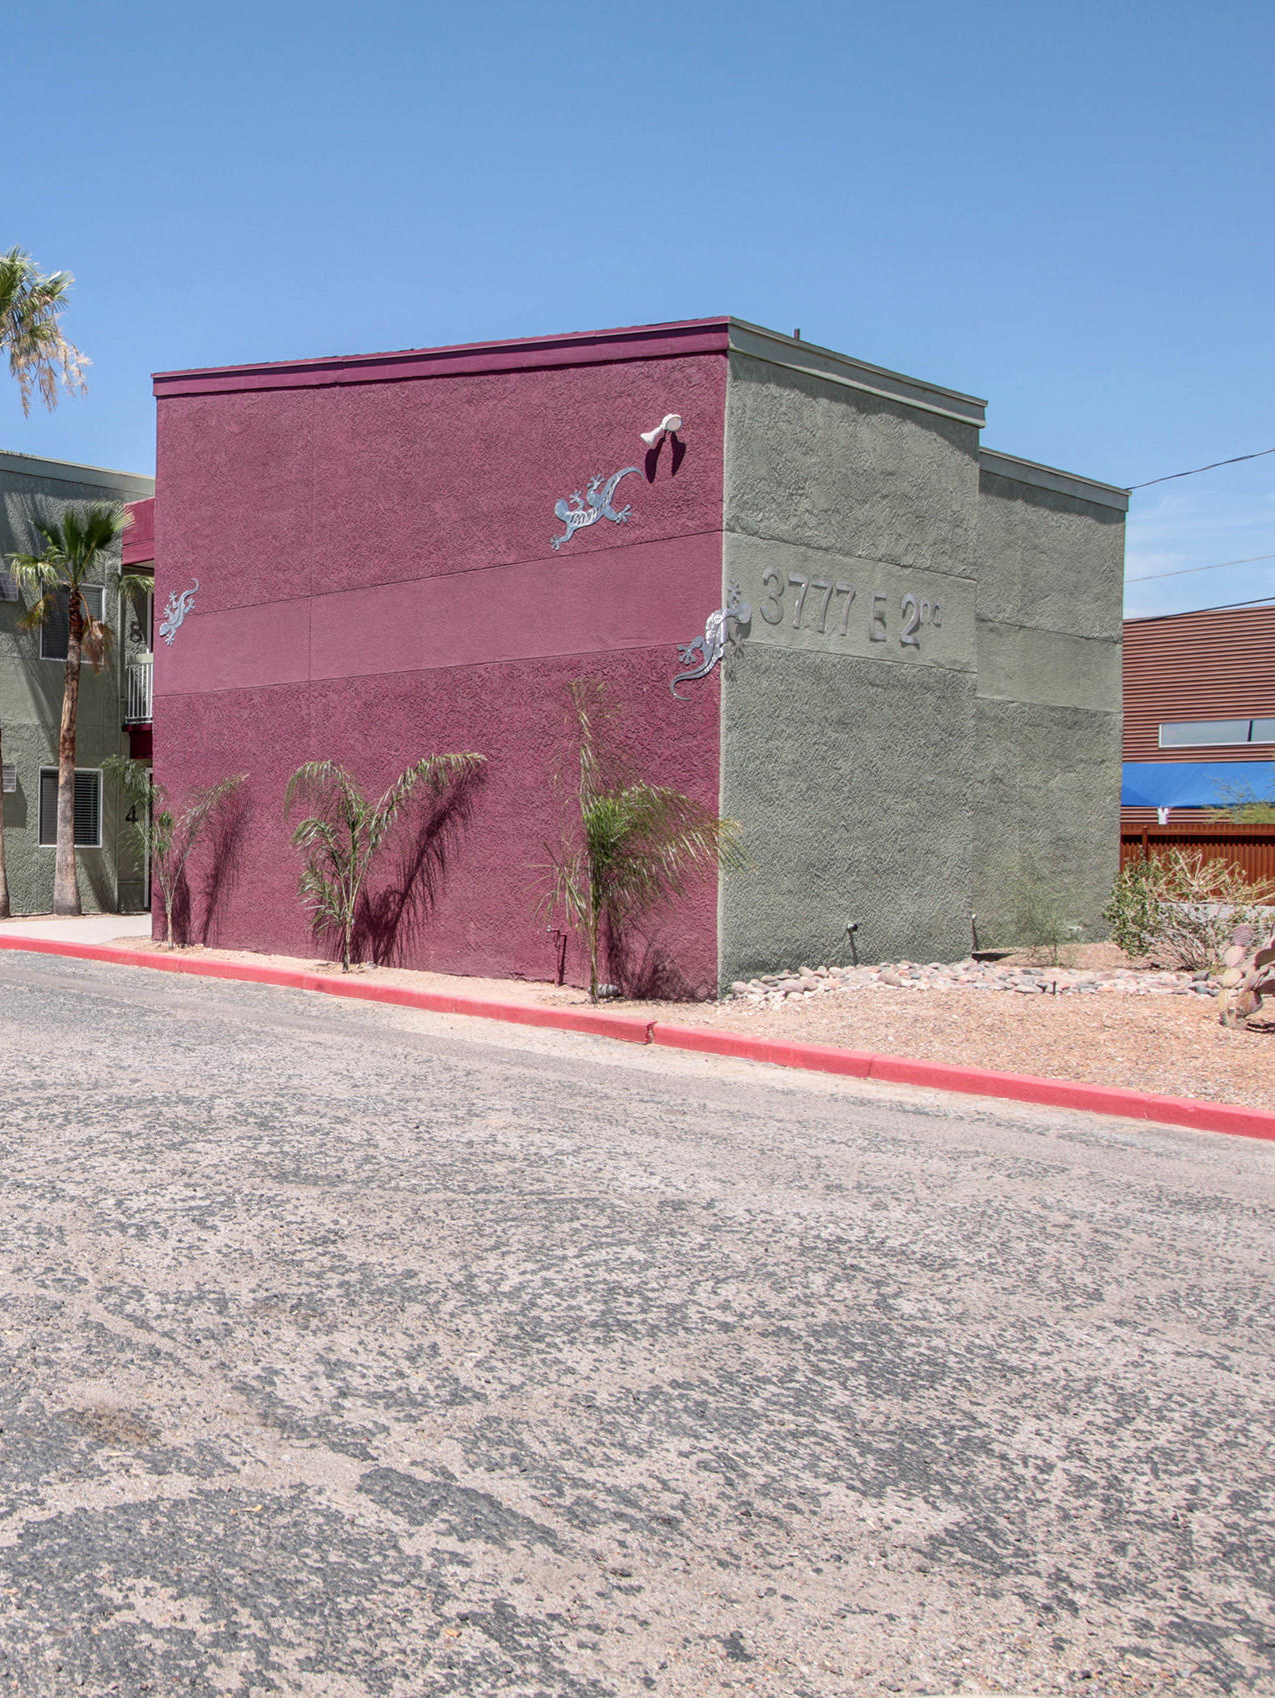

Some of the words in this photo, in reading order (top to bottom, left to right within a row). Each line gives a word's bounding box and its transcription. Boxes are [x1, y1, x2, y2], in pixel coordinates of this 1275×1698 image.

[760, 566, 855, 635] 3777
[869, 591, 887, 642] E
[130, 621, 143, 643] 8
[125, 805, 138, 823] 4
